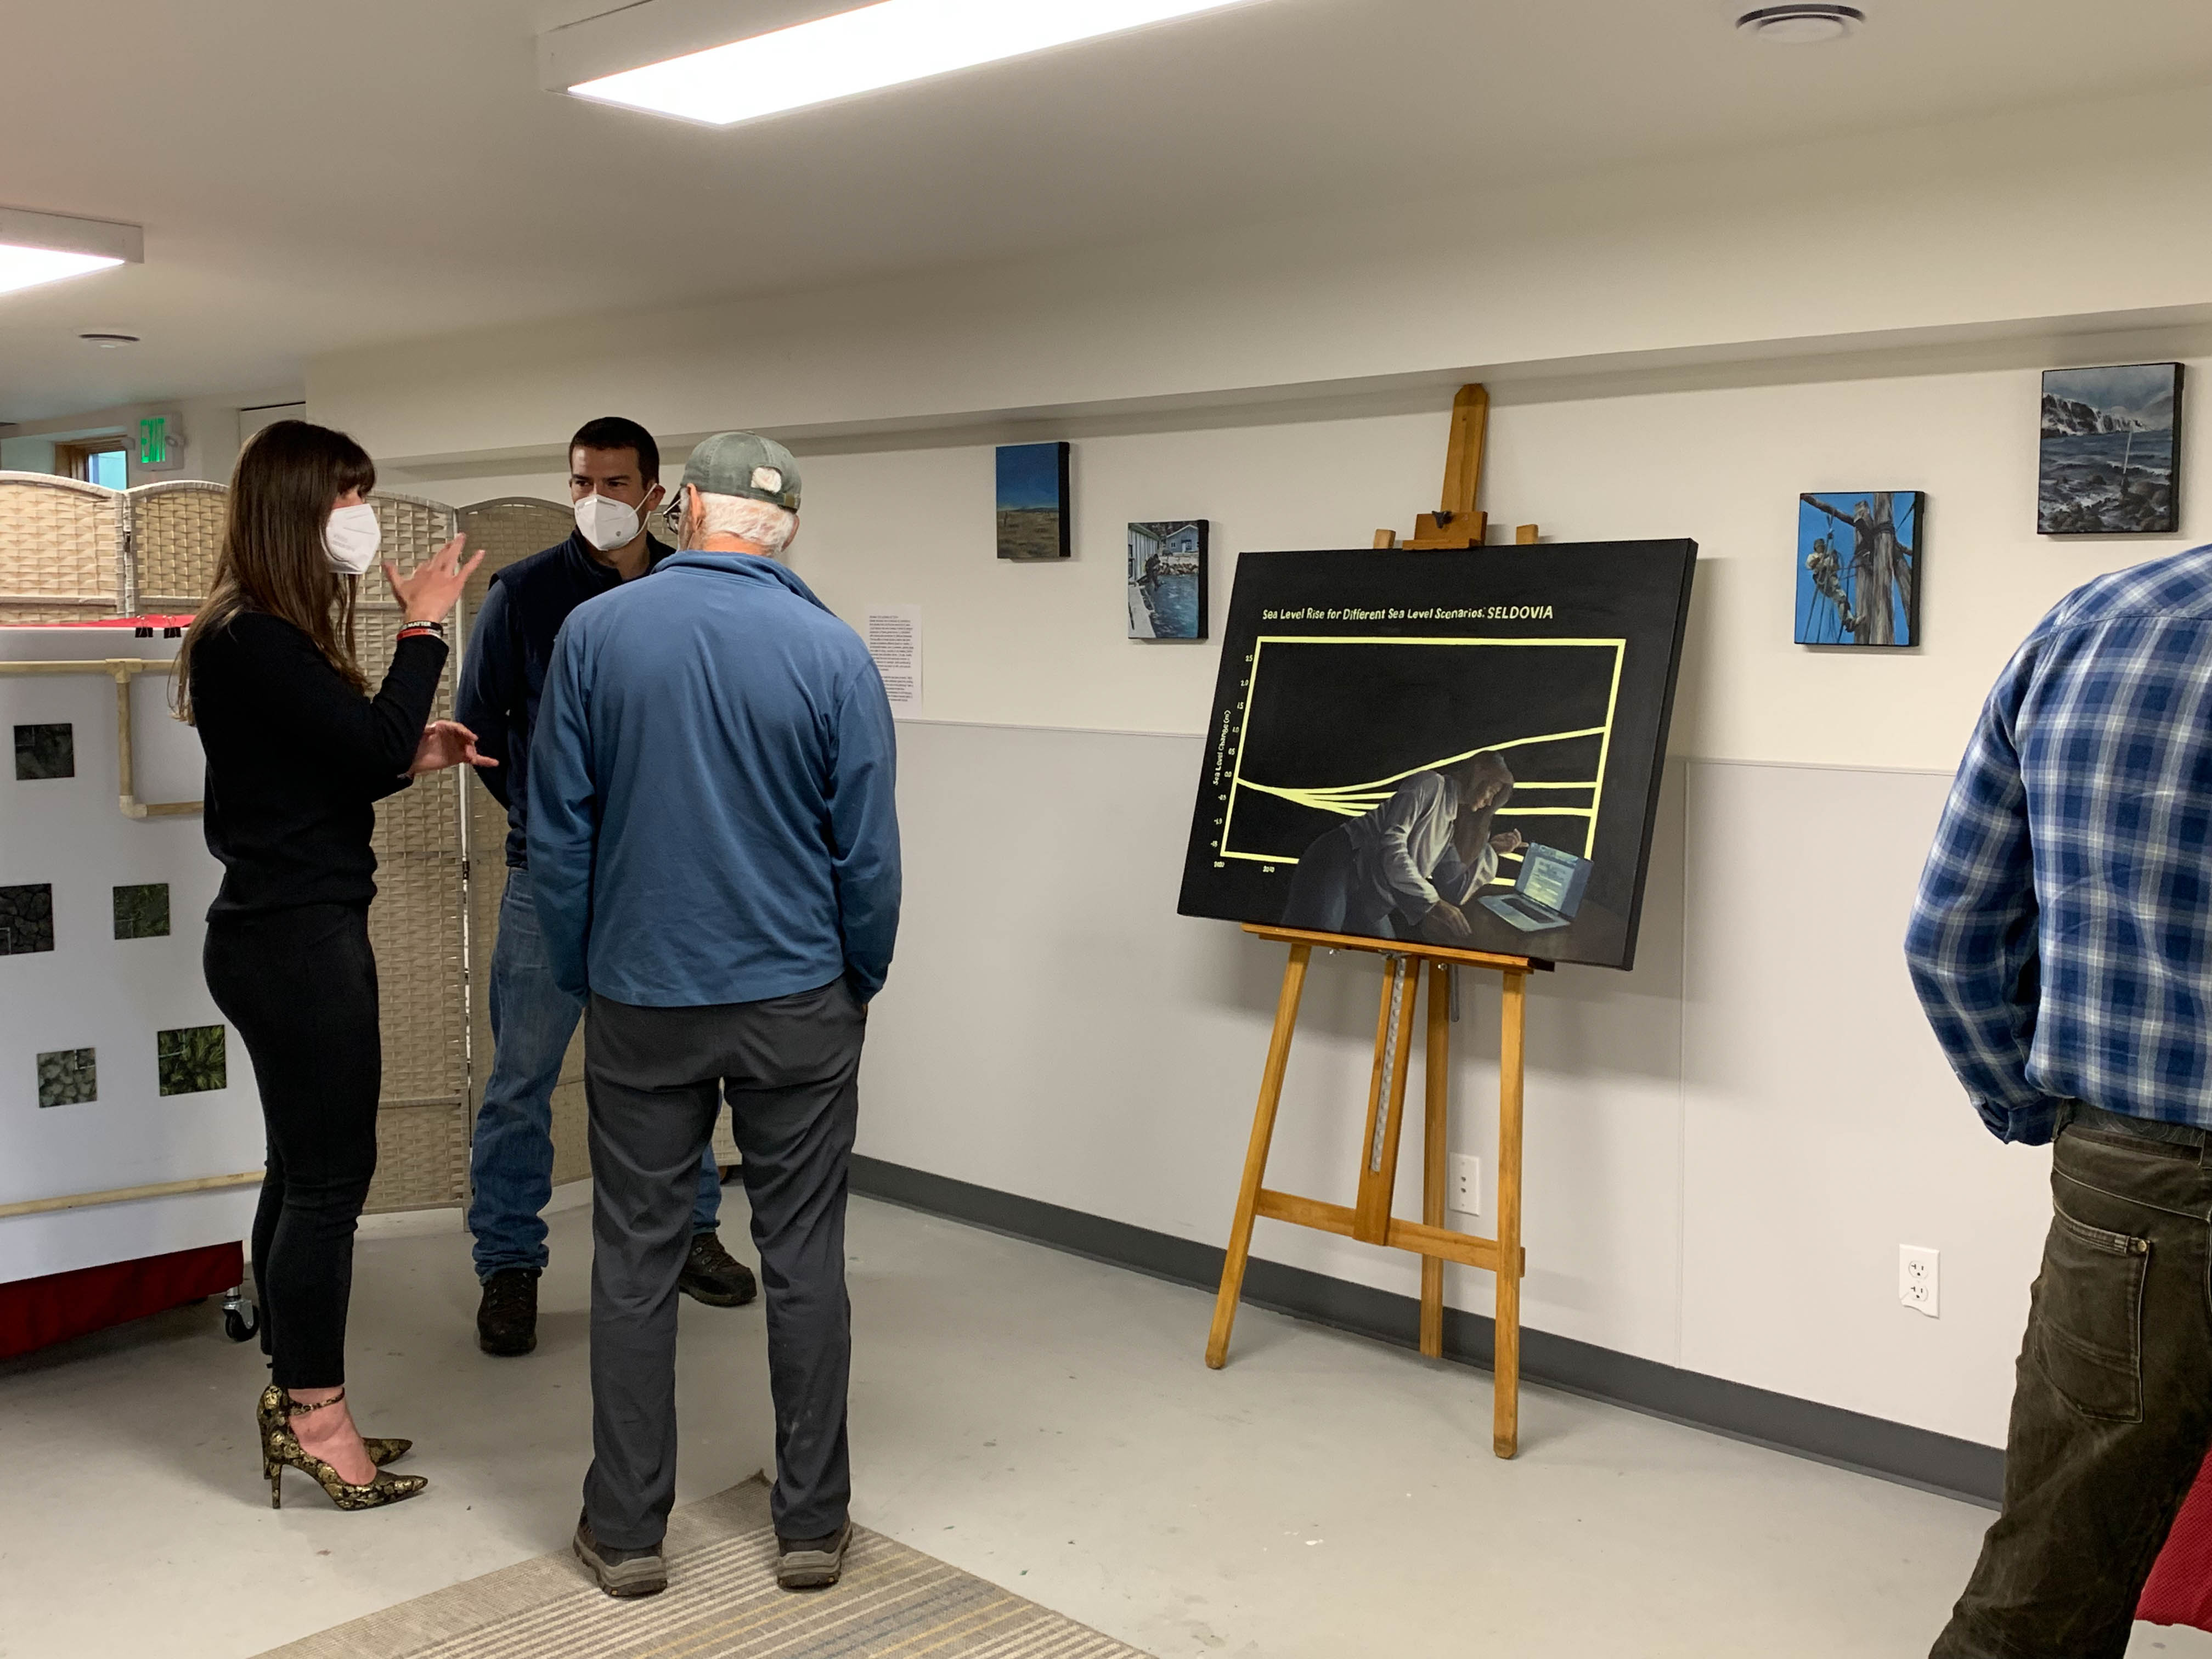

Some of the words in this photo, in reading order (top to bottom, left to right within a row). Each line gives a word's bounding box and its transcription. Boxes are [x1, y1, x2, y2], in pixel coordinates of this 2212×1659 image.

[140, 418, 166, 463] EXIT
[1262, 609, 1278, 620] Sea
[1280, 608, 1305, 619] Level
[1306, 607, 1325, 619] Rise
[1327, 608, 1342, 619] for
[1342, 608, 1386, 620] Different
[1387, 608, 1404, 619] Sea
[1407, 608, 1434, 619] Level
[1487, 605, 1554, 619] SELDOVIA
[1218, 724, 1229, 751] Change
